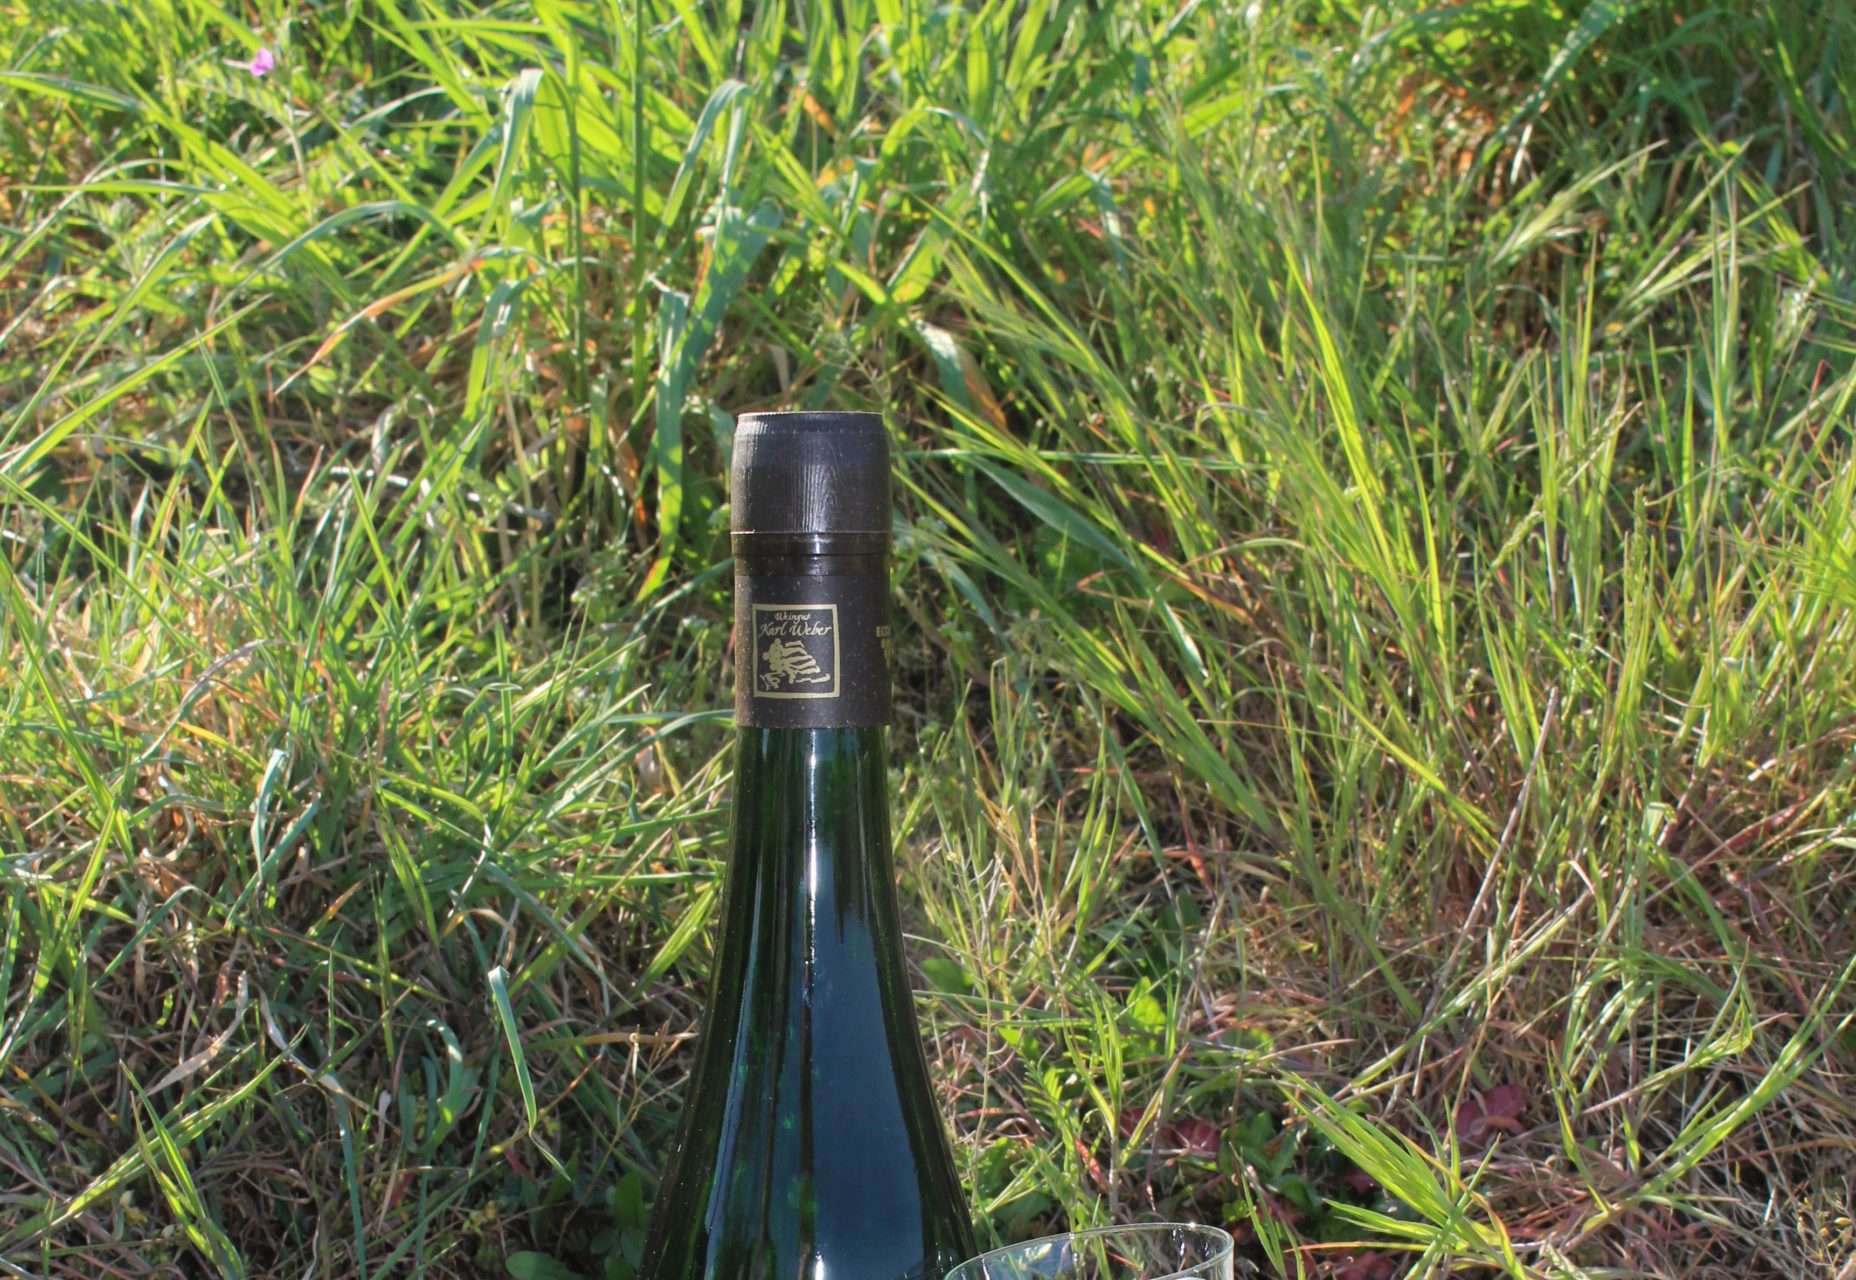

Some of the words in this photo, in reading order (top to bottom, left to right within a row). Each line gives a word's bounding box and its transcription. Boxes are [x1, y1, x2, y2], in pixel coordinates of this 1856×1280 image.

[774, 612, 812, 624] Weingut
[759, 621, 789, 637] Karl
[789, 620, 832, 637] Weber
